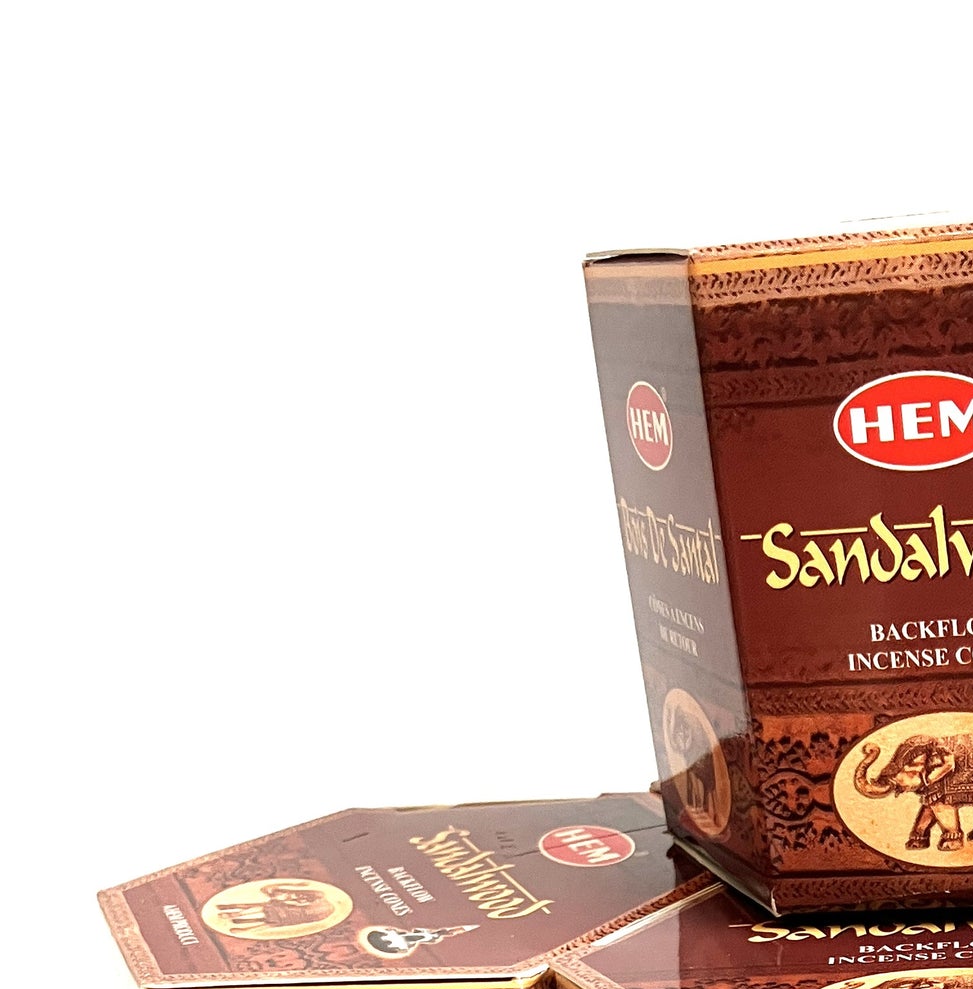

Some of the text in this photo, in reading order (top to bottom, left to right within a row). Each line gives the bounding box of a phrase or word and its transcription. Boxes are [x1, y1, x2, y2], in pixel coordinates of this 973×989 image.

[630, 407, 669, 446] HEM
[848, 645, 949, 671] INCENSE
[552, 828, 622, 864] HEM
[828, 951, 947, 965] INCENSE
